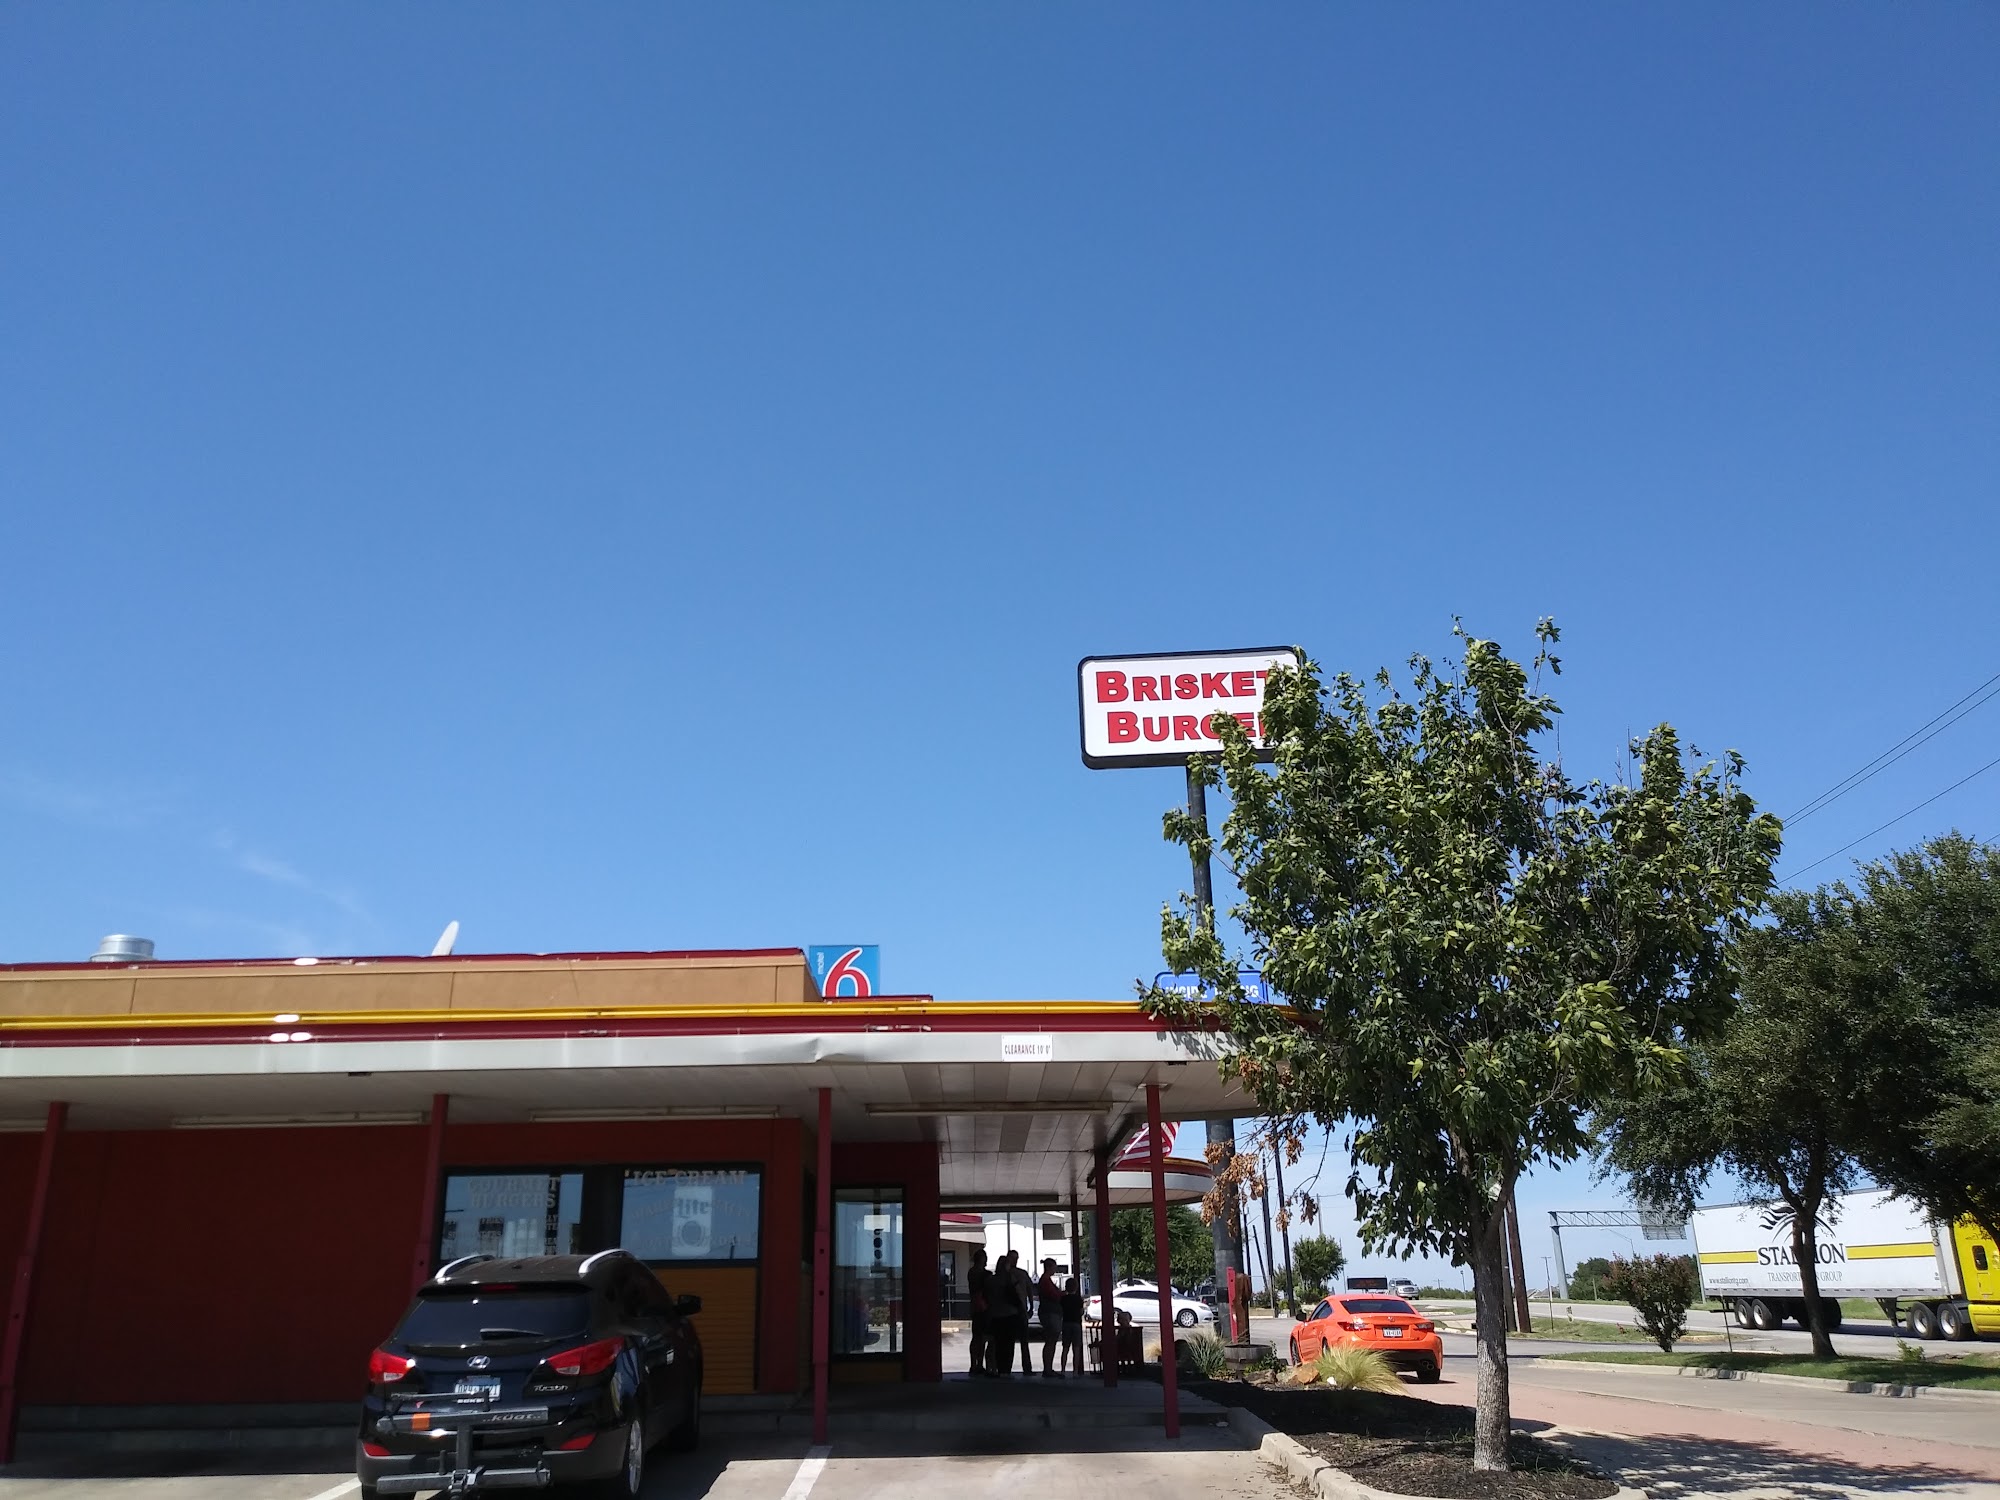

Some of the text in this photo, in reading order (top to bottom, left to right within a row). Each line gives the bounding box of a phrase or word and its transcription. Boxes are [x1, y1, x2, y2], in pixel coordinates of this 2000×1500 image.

[1107, 711, 1266, 743] BURE
[822, 947, 872, 997] 6
[1004, 1044, 1035, 1055] CLEARANCE
[632, 1170, 748, 1186] ICE CREAM
[471, 1193, 556, 1208] BURGERS
[1758, 1243, 1846, 1266] STALION
[1820, 1270, 1843, 1282] GROUP
